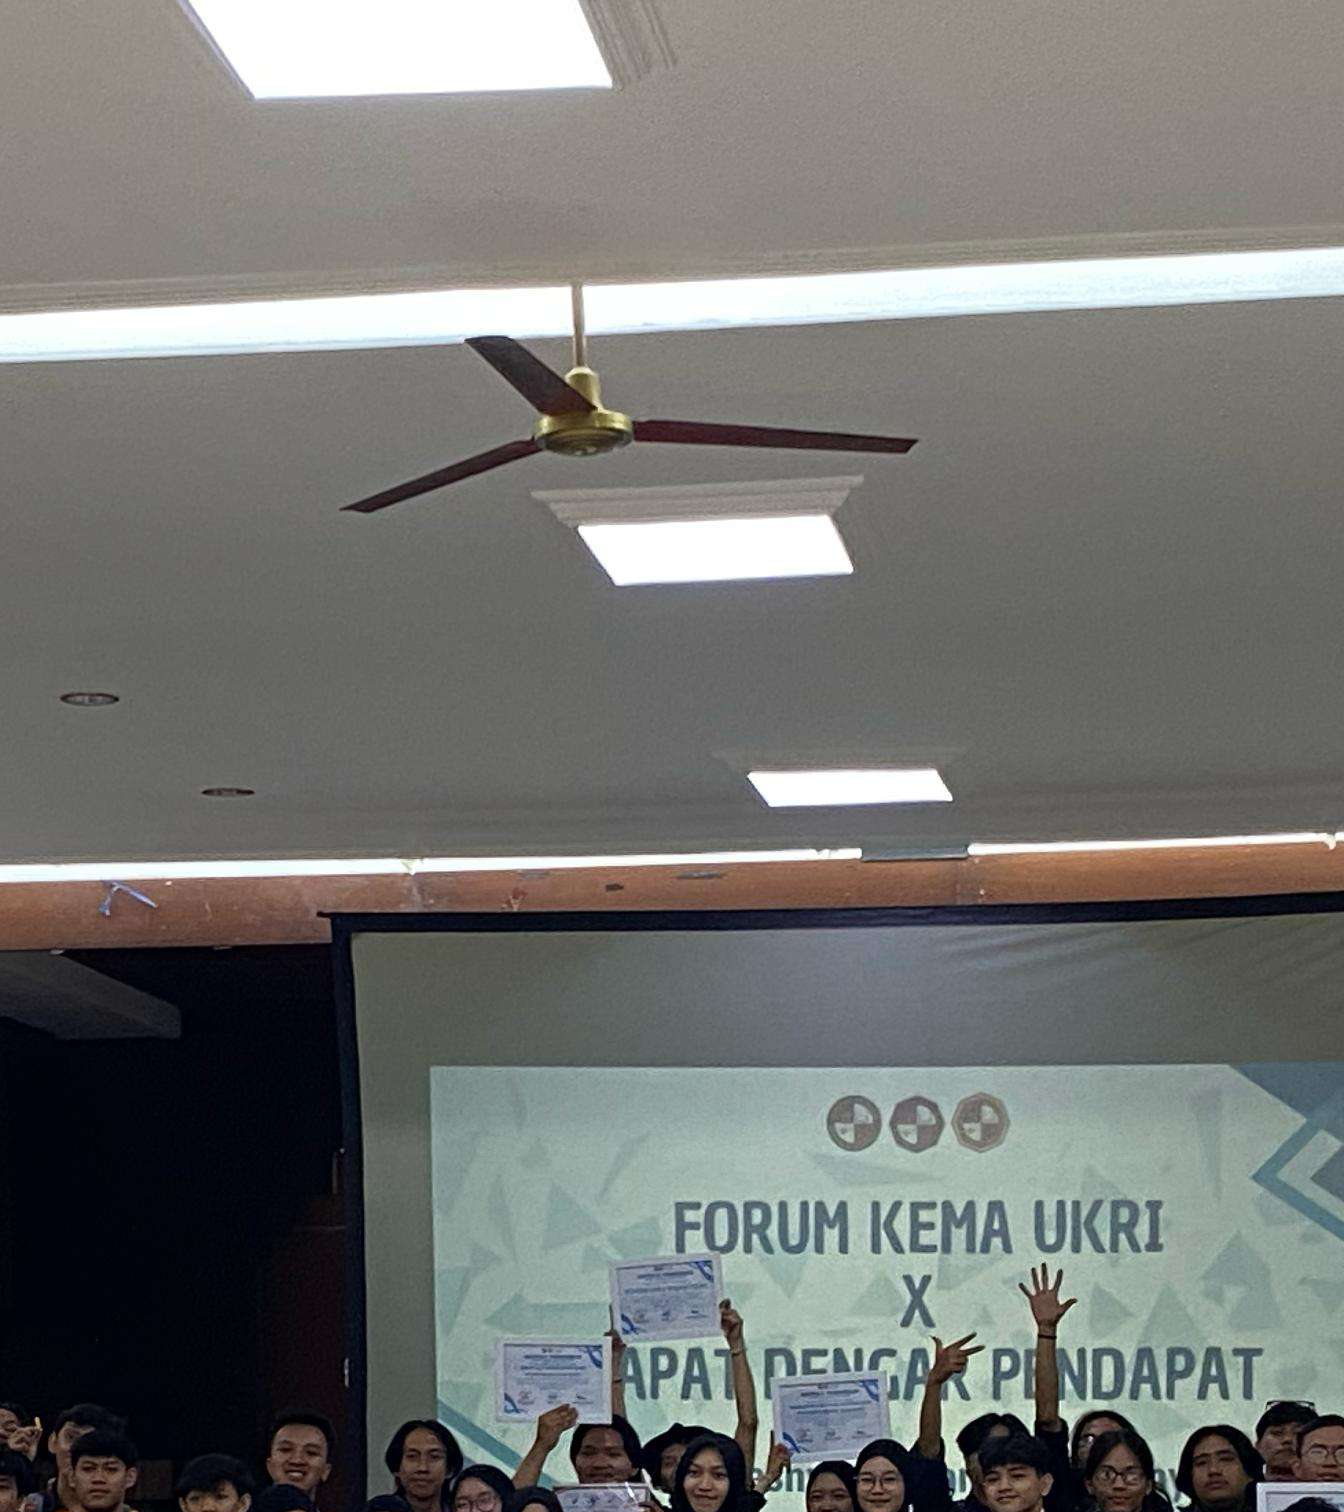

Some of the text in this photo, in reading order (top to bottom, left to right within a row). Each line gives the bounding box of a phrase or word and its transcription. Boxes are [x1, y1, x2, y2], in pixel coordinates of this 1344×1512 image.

[674, 1199, 1164, 1255] FORUM KEMA UKRI
[899, 1274, 936, 1328] X
[620, 1346, 735, 1401] APAT
